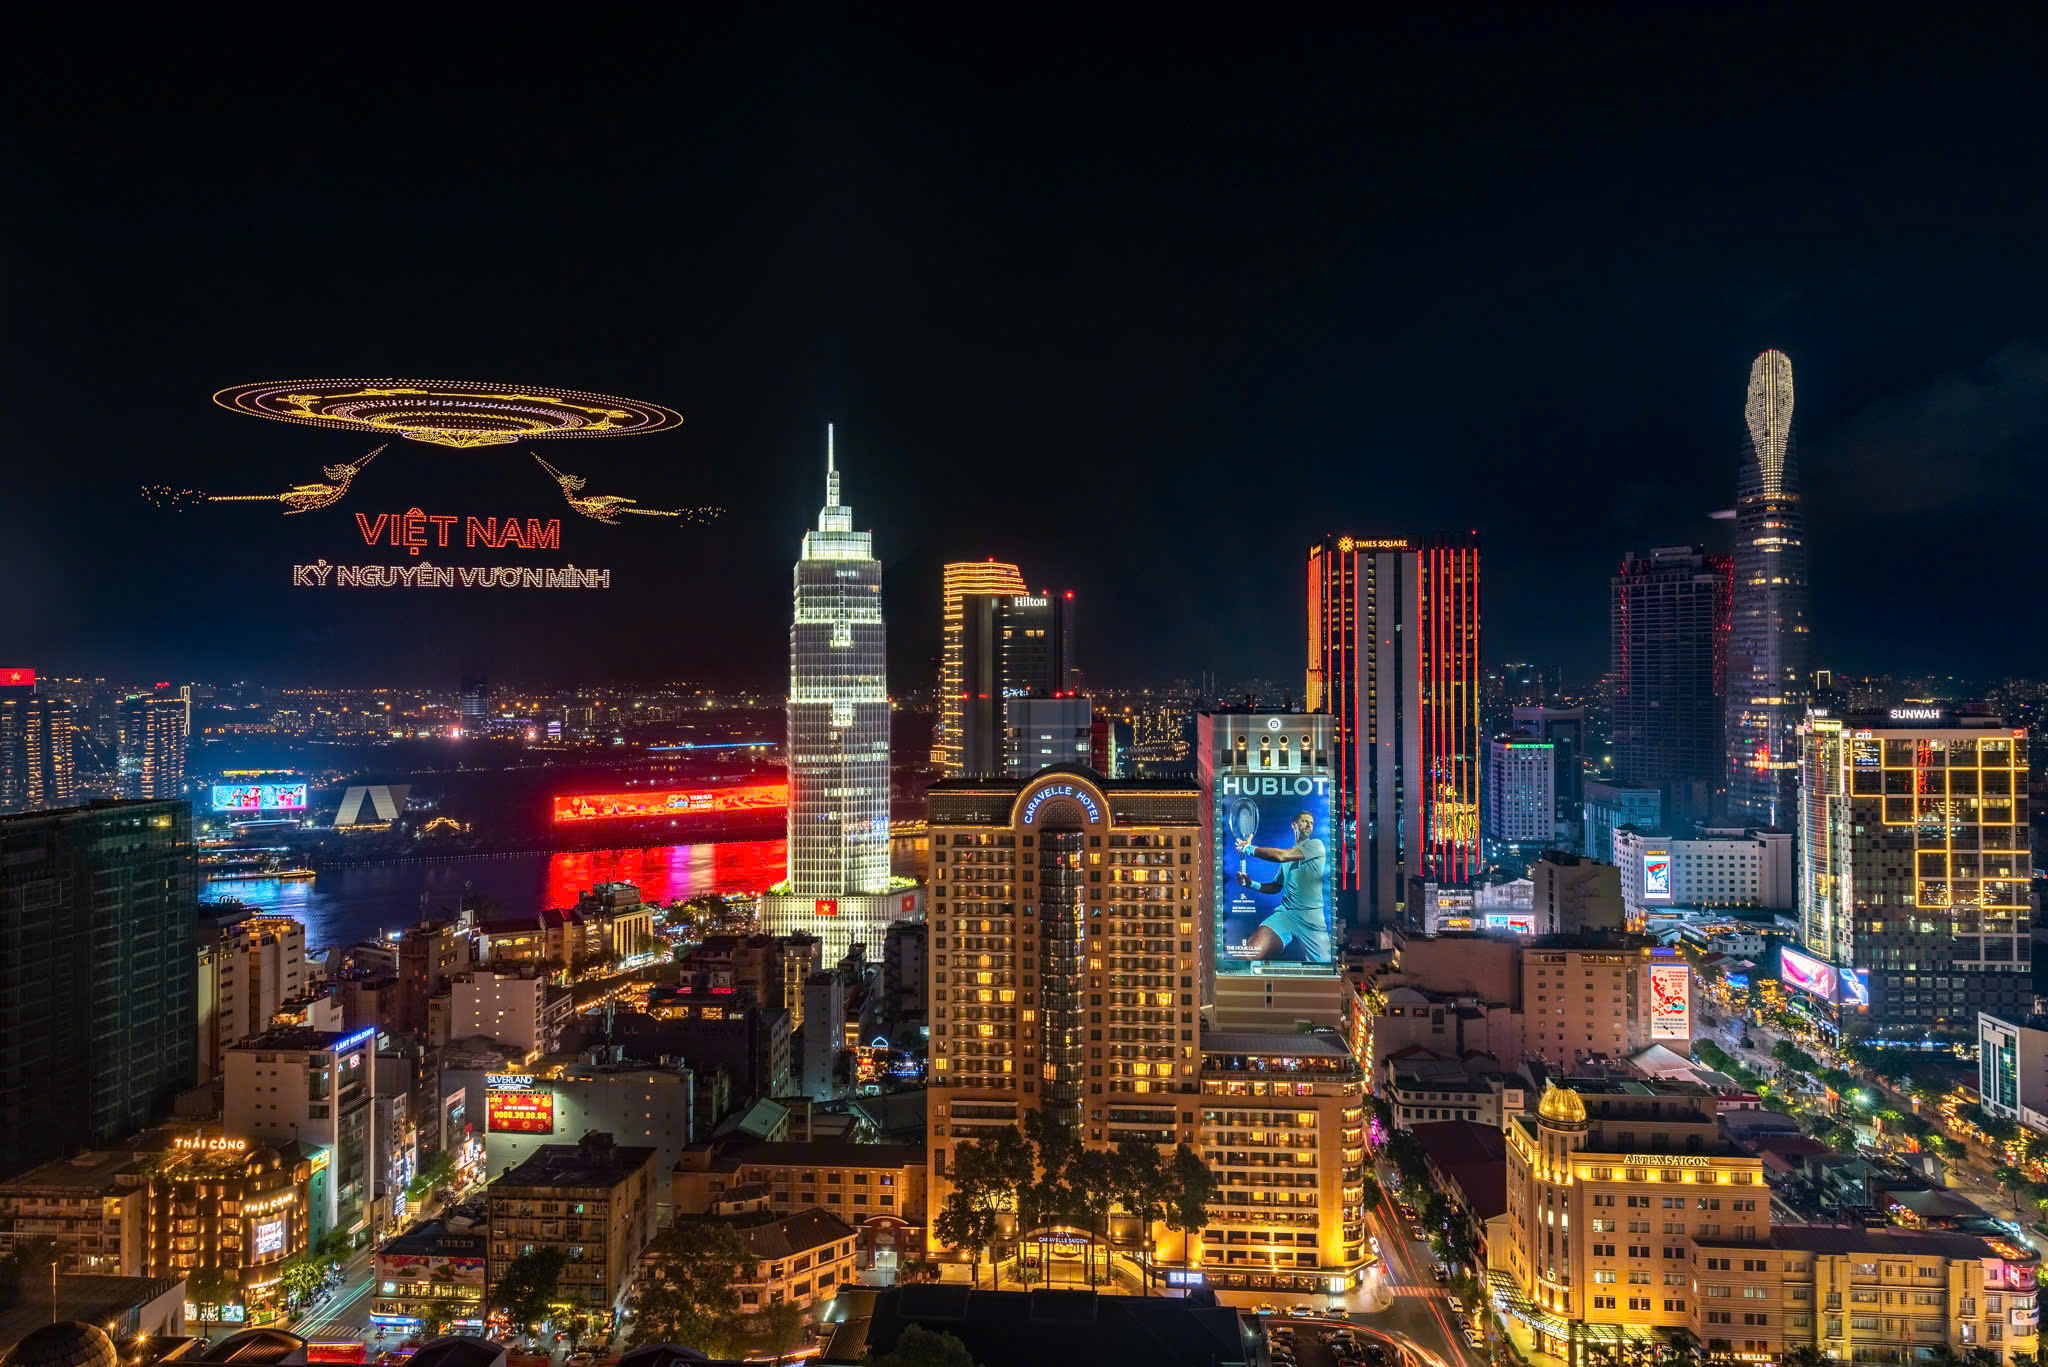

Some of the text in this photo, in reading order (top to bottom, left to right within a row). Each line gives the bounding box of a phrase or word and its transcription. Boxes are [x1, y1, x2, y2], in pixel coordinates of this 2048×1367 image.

[355, 507, 560, 556] VIỆT NAM
[1355, 540, 1408, 548] TIMES SQUARE
[293, 559, 611, 588] KỶ NGUYÊN VƯƠN MÌNH
[1015, 597, 1047, 607] Hilton
[1890, 709, 1940, 719] SUNWAH
[1223, 777, 1329, 796] HUBLOT
[1024, 786, 1099, 824] CARAVELLE HOTEL
[487, 1076, 532, 1084] SILVERLAND
[175, 1137, 245, 1150] THÁI CÔNG
[1624, 1154, 1710, 1166] ARTEX SAIGON
[1741, 1353, 1773, 1361] MULLER
